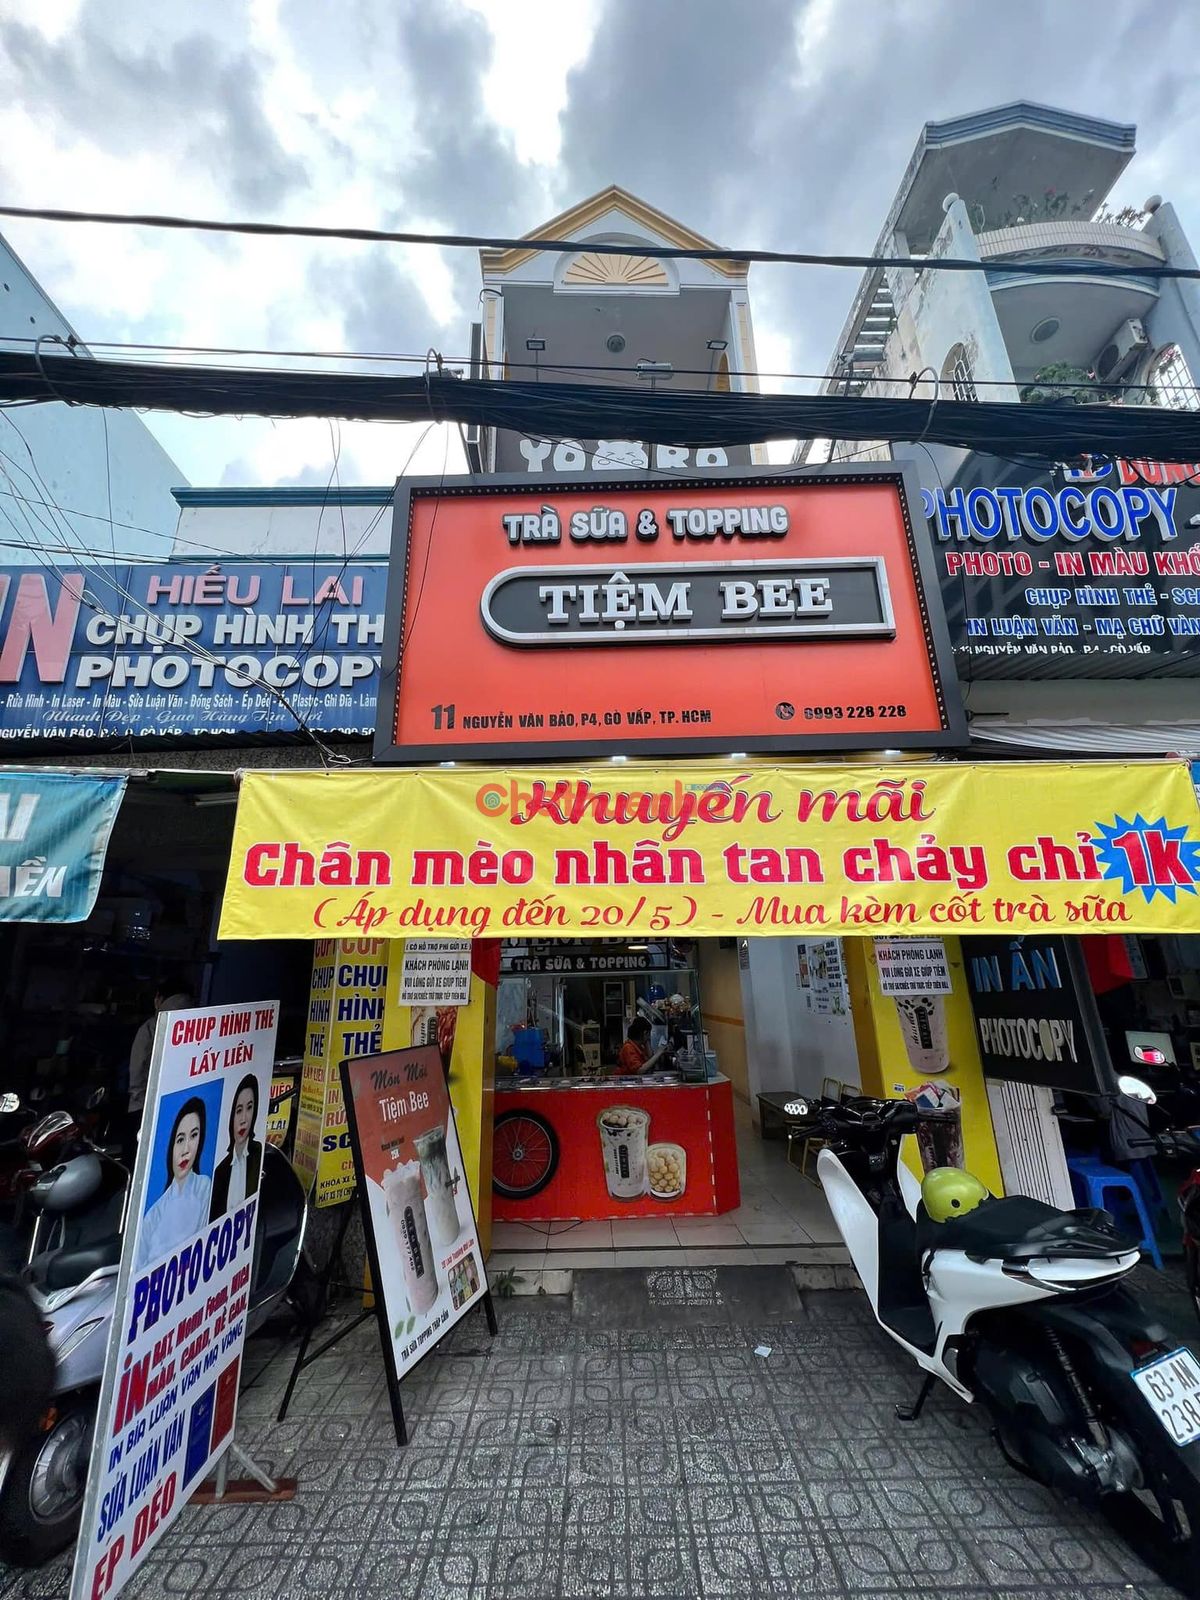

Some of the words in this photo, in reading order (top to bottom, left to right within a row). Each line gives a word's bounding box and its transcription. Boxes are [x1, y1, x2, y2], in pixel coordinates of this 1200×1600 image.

[504, 504, 560, 542] TRÀ
[570, 507, 627, 541] SỮA
[637, 510, 656, 540] &
[668, 505, 789, 539] TOPPING
[946, 552, 1033, 576] PHOTO
[1054, 552, 1085, 576] IN
[1088, 547, 1149, 576] MÀU
[147, 564, 260, 606] HIẾU
[539, 571, 693, 630] TIỆM
[720, 578, 832, 619] BEE
[1026, 588, 1071, 609] CHỤP
[1075, 586, 1120, 605] HÌNH
[1123, 583, 1156, 605] THẺ
[86, 614, 203, 654] CHỤP
[213, 607, 314, 645] HÌNH
[992, 616, 1036, 639] LUẬN
[1042, 615, 1079, 635] VĂN
[75, 655, 383, 688] PHOTOCOP
[62, 694, 85, 708] Laser
[431, 704, 456, 729] 11
[463, 709, 513, 729] NGUYỄN
[519, 710, 544, 728] VĂN
[682, 709, 712, 723] HCM
[847, 706, 874, 718] 228
[878, 705, 906, 718] 228
[510, 774, 783, 842] Khuyến
[797, 777, 936, 824] mãi
[243, 841, 392, 887] Chân
[411, 840, 534, 887] mèo
[554, 838, 705, 885] nhân
[723, 843, 824, 884] tan
[843, 833, 989, 890] chảy
[1007, 831, 1104, 881] chỉ
[400, 896, 491, 936] dụng
[503, 894, 571, 926] đến
[737, 896, 830, 924] Mua
[840, 897, 927, 923] kèm
[929, 890, 982, 923] cốt
[992, 897, 1057, 923] trà
[1065, 899, 1133, 922] sữa
[405, 958, 427, 970] KHÁCH
[514, 956, 541, 971] TRÀ
[546, 956, 572, 971] SỮA
[590, 956, 647, 969] TOPPING
[878, 948, 900, 960] KHÁCH
[971, 955, 1003, 992] IN
[172, 1017, 216, 1047] CHỤP
[219, 1010, 251, 1037] HÌNH
[343, 1023, 382, 1056] THẺ
[979, 1018, 1078, 1063] PHOTOCOPY
[190, 1047, 220, 1077] LẤY
[223, 1040, 254, 1068] LIỀN
[379, 1096, 408, 1123] Tiệm
[409, 1090, 429, 1112] Bee
[127, 1199, 256, 1347] PHOTOCOPY
[1161, 1392, 1200, 1440] 238
[108, 1440, 123, 1474] IN
[128, 1435, 161, 1508] LUẬN
[162, 1409, 185, 1467] VĂN
[130, 1471, 177, 1561] DẺO
